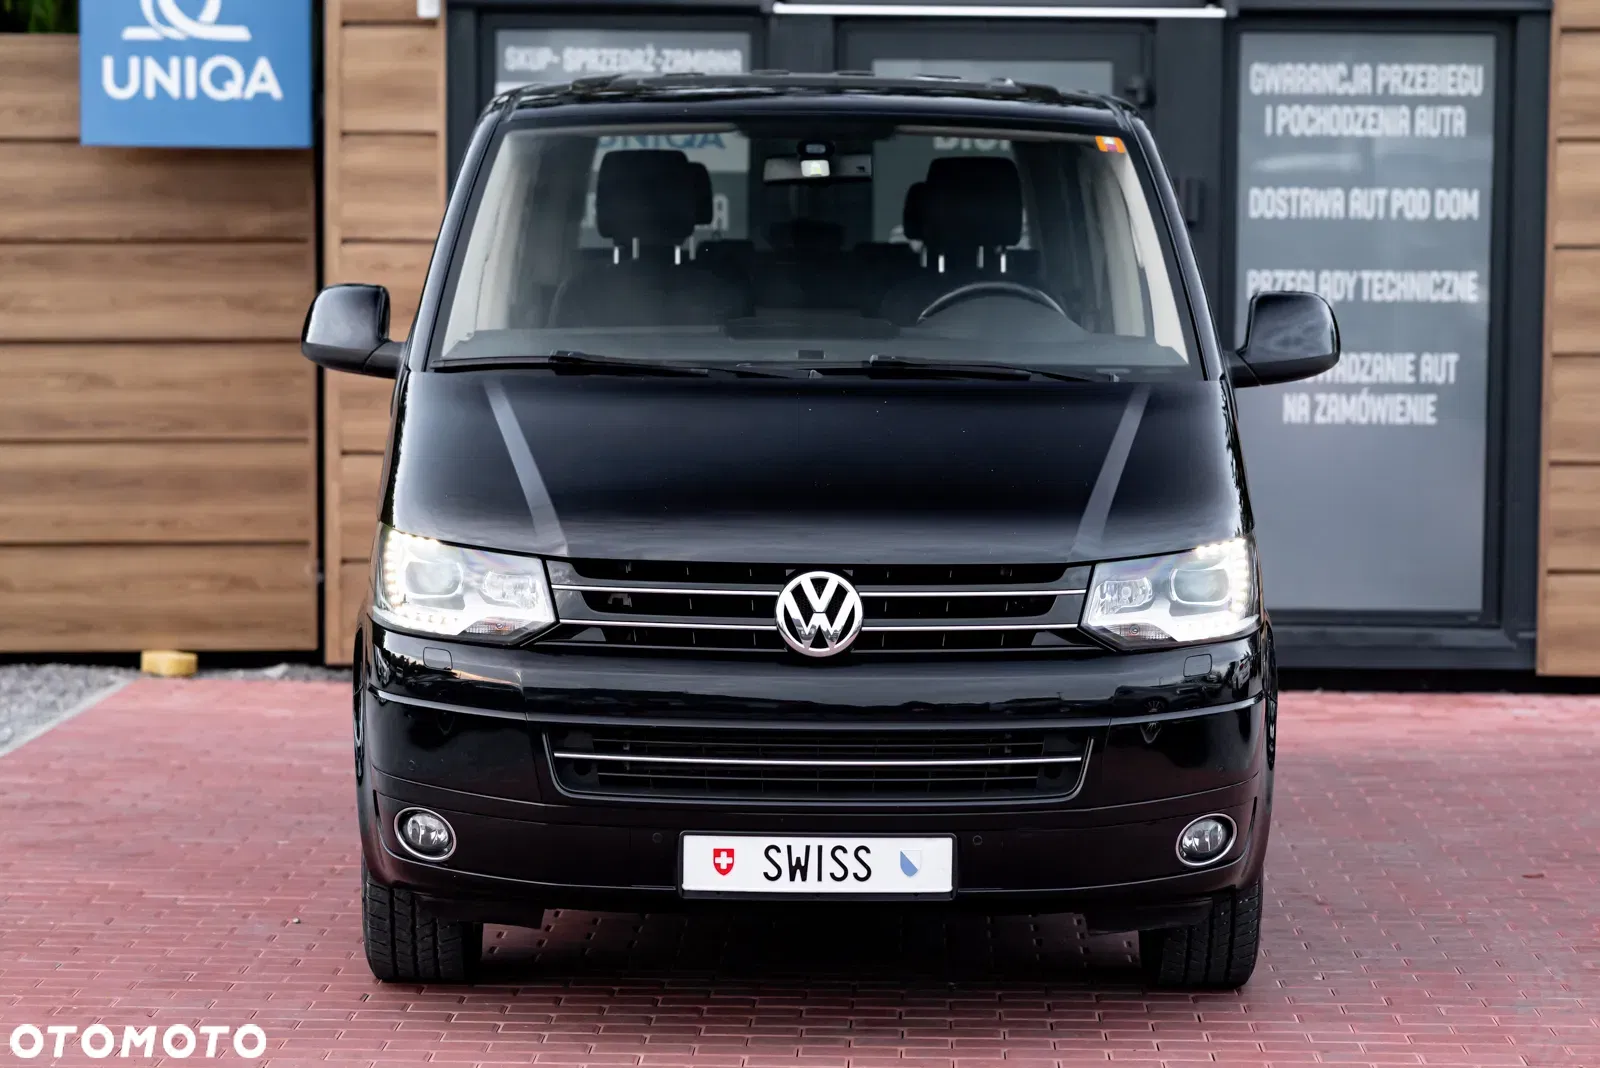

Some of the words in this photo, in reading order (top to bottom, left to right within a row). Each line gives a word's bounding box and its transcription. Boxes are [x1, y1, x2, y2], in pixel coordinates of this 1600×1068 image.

[102, 54, 283, 101] UNIQA
[1250, 62, 1373, 95] GWARANCJA
[1376, 63, 1484, 97] PRZEBIEGU
[1264, 103, 1274, 137] I
[1276, 103, 1410, 137] POCHODZENIA
[1414, 105, 1467, 138] AUTA
[1249, 187, 1345, 219] DOSTAWA
[1348, 187, 1388, 220] AUT
[1390, 187, 1431, 221] POD
[1434, 188, 1480, 221] DOM
[1359, 269, 1479, 303] TECHNICZNE
[1419, 353, 1460, 385] AUT
[1282, 392, 1311, 424] NA
[1313, 387, 1438, 425] ZAMÓWIENIE
[763, 844, 872, 882] SWISS
